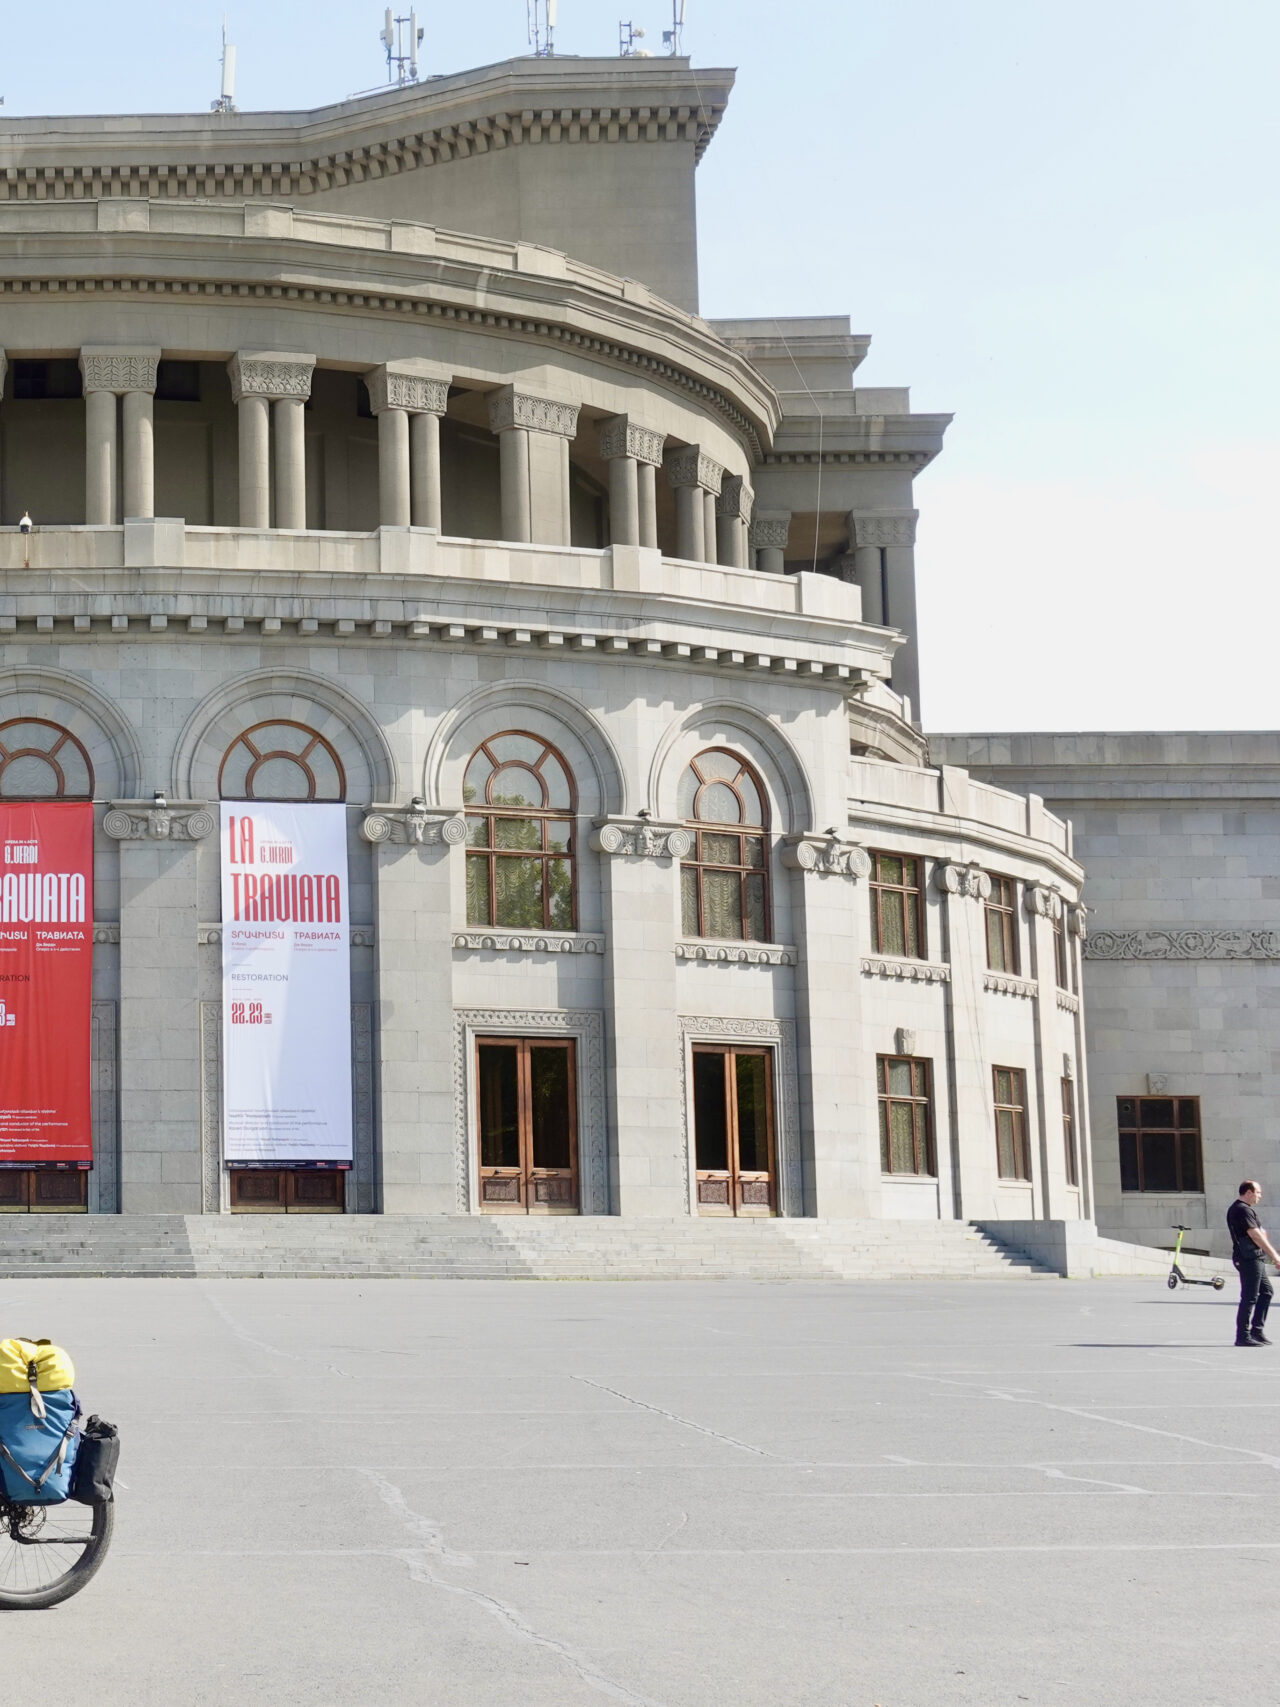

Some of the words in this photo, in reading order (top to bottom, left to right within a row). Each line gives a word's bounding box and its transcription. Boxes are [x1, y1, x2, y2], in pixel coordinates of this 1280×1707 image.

[229, 816, 254, 864] LA
[230, 873, 341, 923] TRAVIATA
[36, 931, 84, 940] ТРАВИАТА
[231, 931, 285, 940] ՏՐԱՎԻԱՏԱ
[294, 931, 341, 940] ТРАВИАТА
[232, 974, 288, 982] RESTORATION
